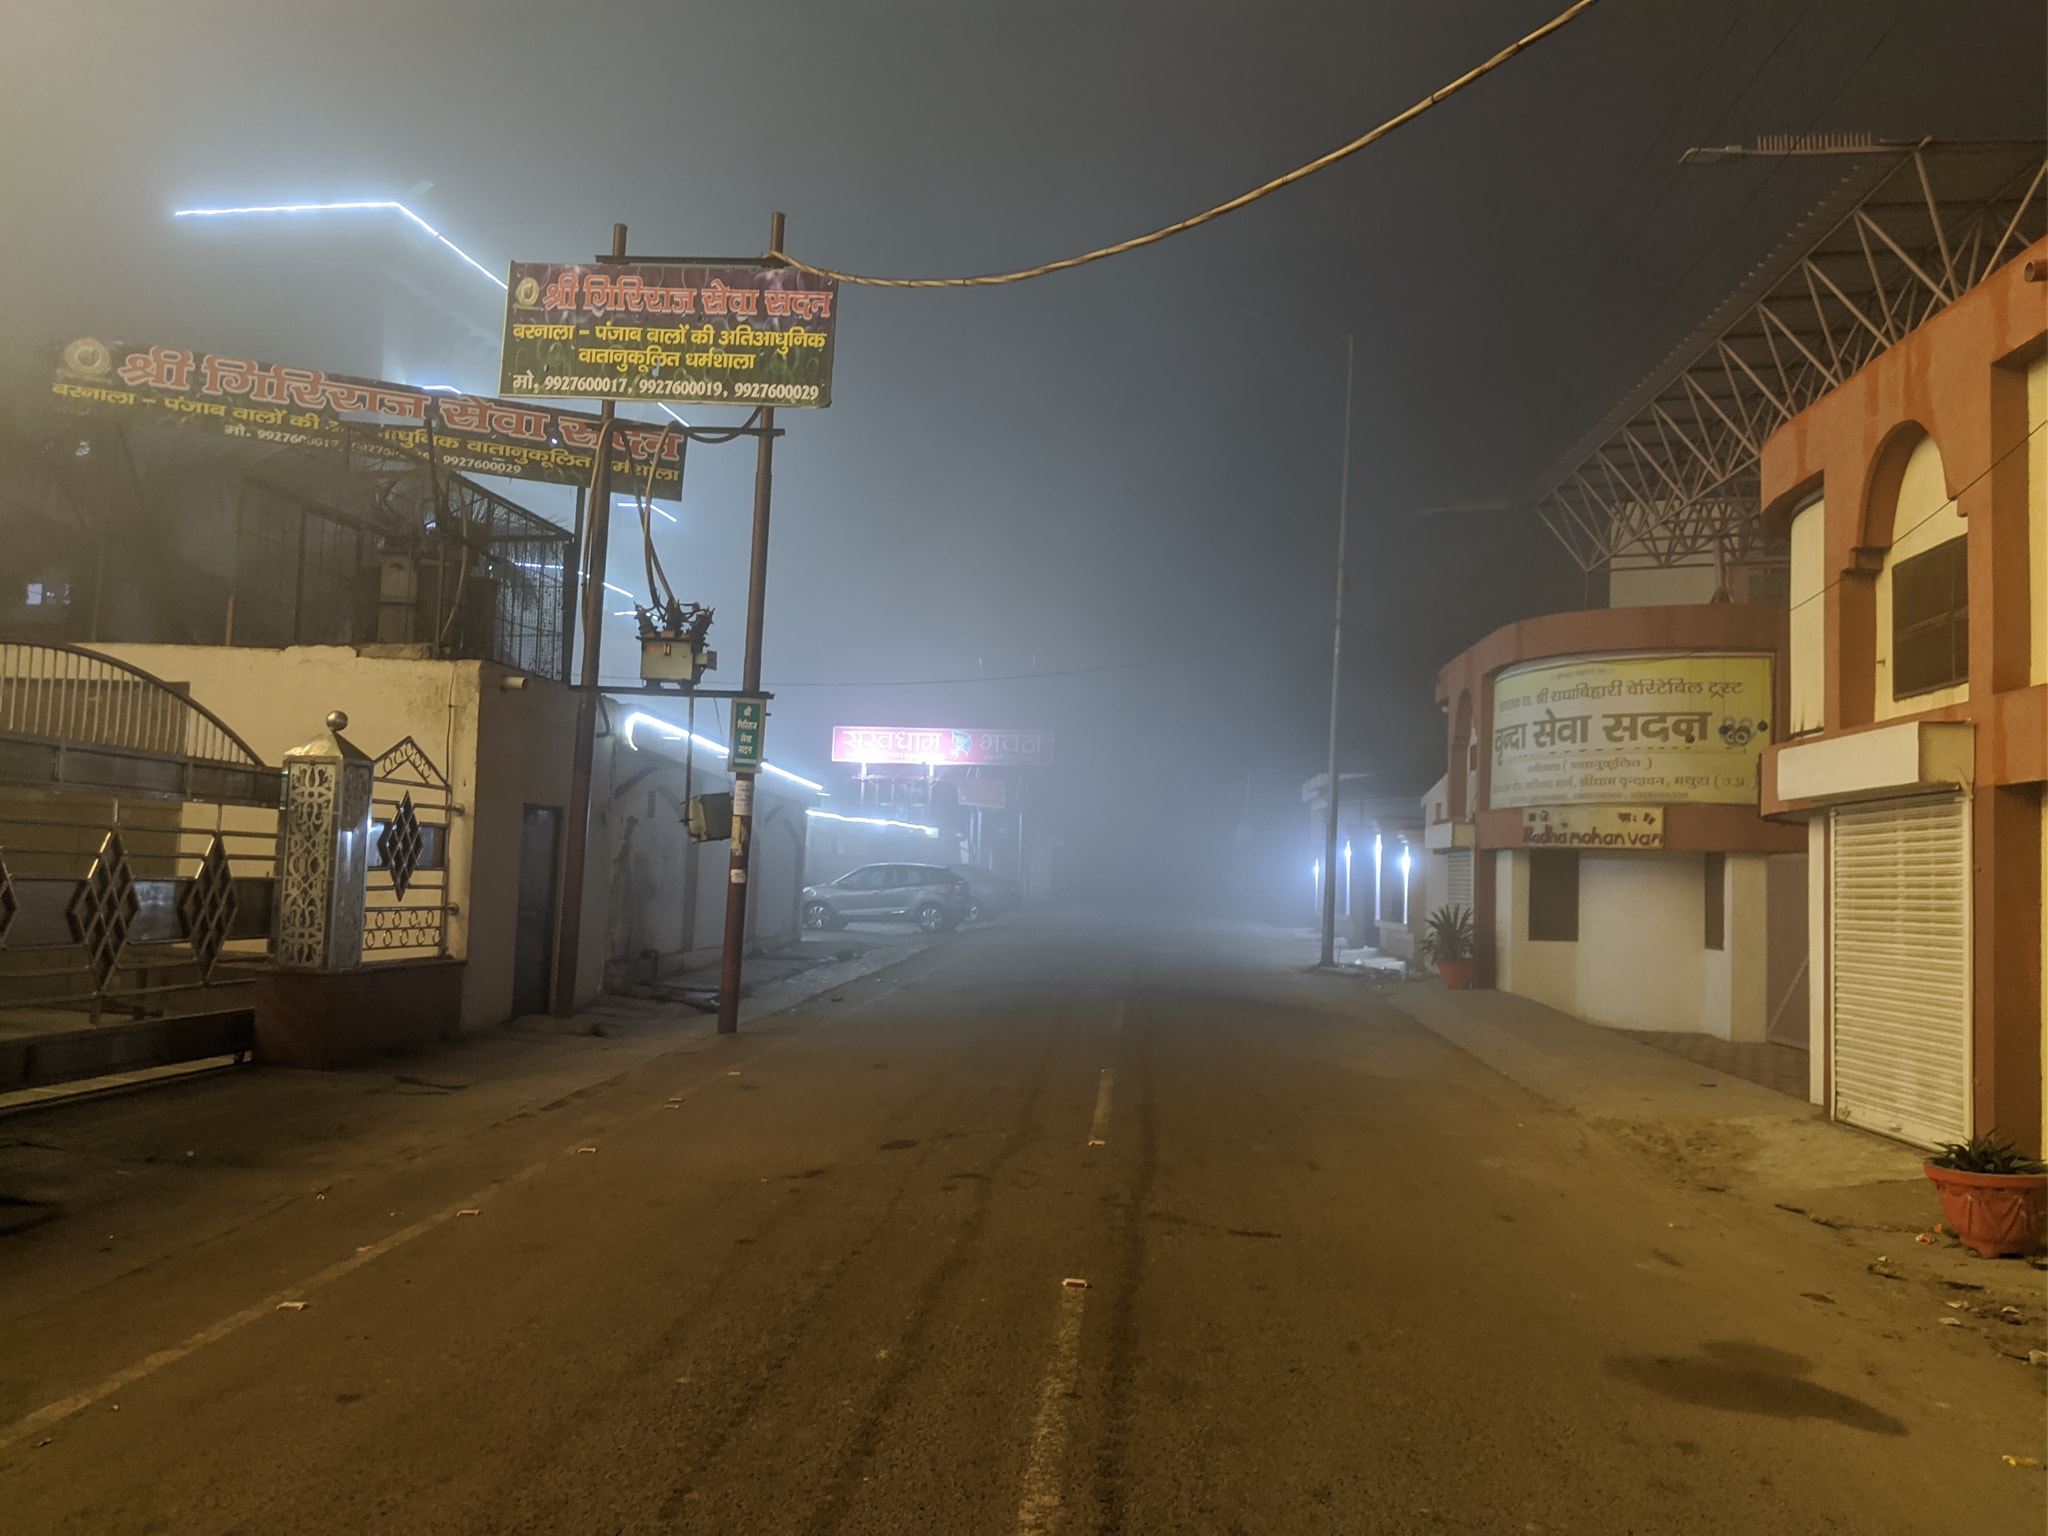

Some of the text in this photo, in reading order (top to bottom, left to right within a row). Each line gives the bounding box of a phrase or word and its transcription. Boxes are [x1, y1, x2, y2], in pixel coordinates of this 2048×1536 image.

[543, 273, 834, 320] श्री गिरिराज सेवा सदन
[512, 323, 576, 341] बरनाला
[594, 320, 644, 343] पंजाब
[646, 323, 691, 345] वालों
[690, 326, 716, 347] की
[717, 325, 828, 354] अतिआधुनिक
[578, 344, 757, 374] वातानुकूलित धर्मशाला
[117, 345, 195, 391] श्री
[200, 353, 432, 421] गिरिराज
[439, 394, 551, 441] सेवा
[544, 374, 632, 394] 9927600017,
[638, 380, 729, 399] 9927600019,
[733, 382, 820, 401] 9927600029
[51, 381, 137, 405] बरनाला
[163, 395, 227, 417] पंजाब
[231, 404, 290, 426] वालों
[289, 410, 321, 431] की
[466, 438, 592, 469] वातानुकूलित
[442, 453, 523, 476] 9927600029
[979, 733, 1044, 754] भवन
[1532, 708, 1593, 749] सेवा
[1601, 711, 1713, 744] सदन
